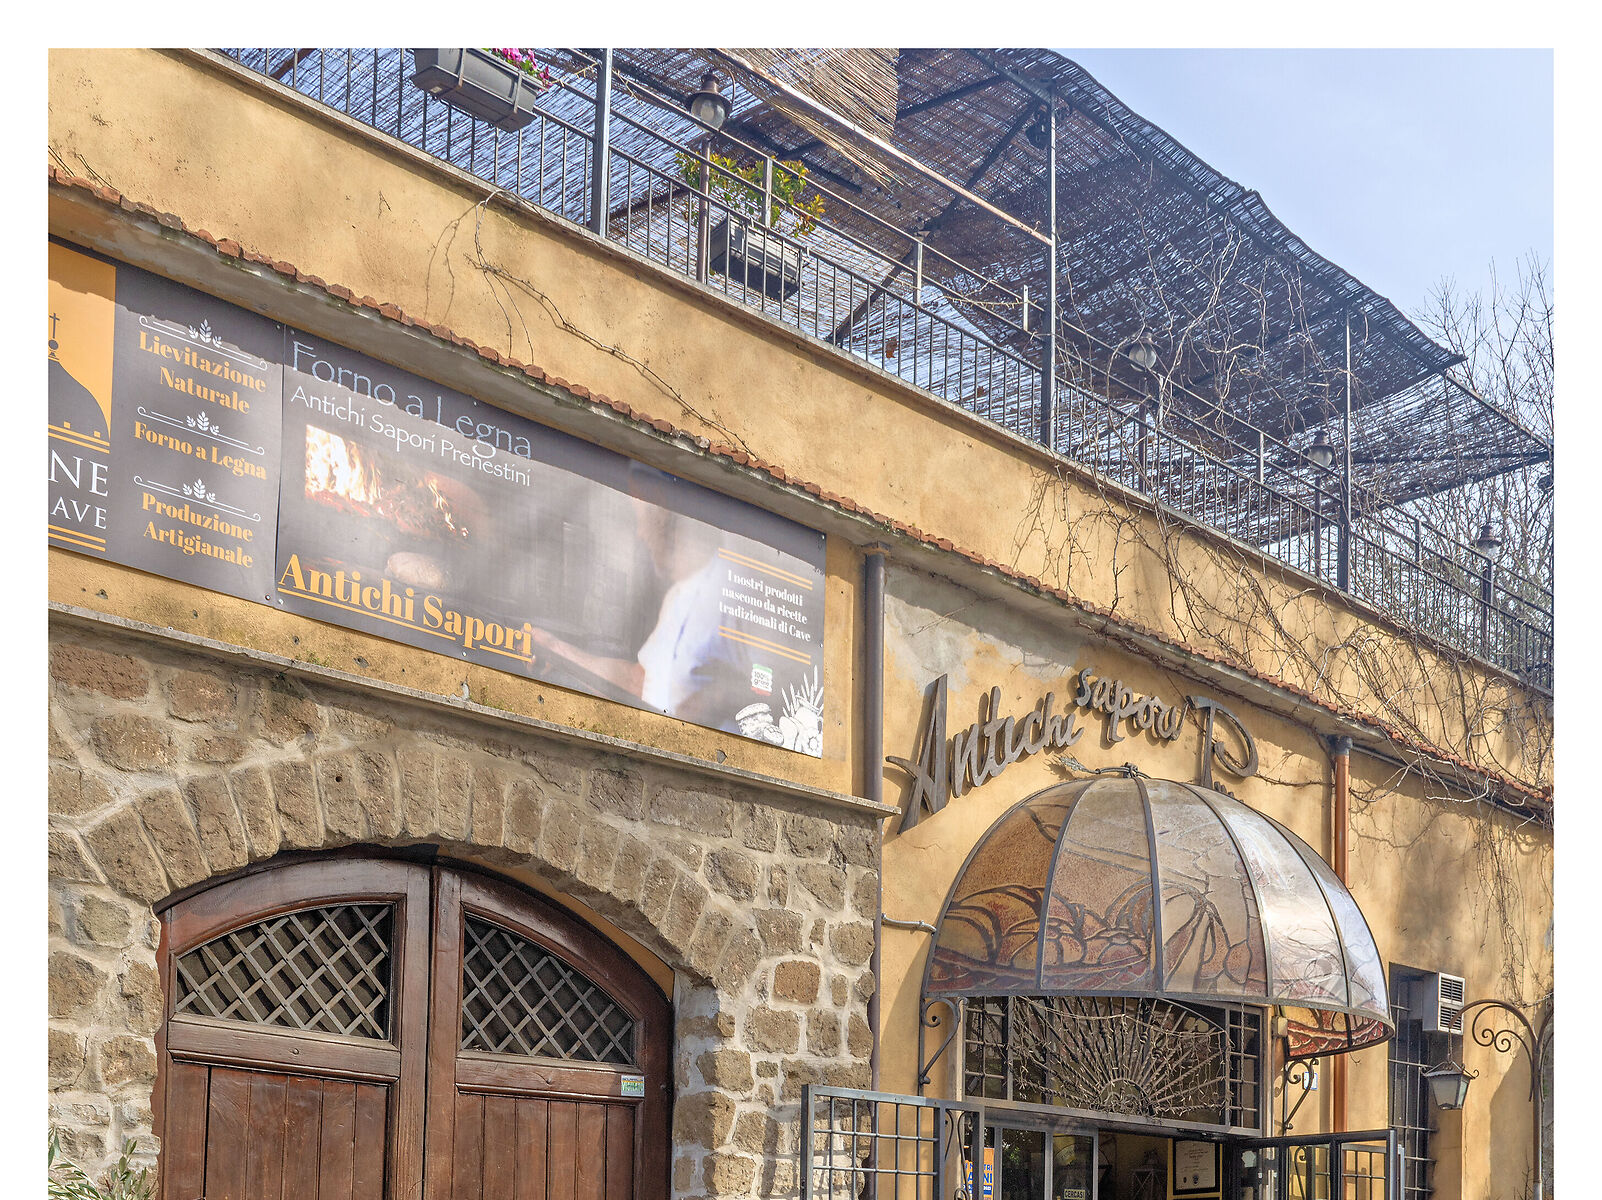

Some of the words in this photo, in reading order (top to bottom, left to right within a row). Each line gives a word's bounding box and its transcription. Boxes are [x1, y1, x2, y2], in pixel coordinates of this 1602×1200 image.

[139, 331, 266, 393] Lievitazione
[160, 366, 249, 414] Naturale
[291, 341, 396, 406] Forno
[407, 394, 424, 419] a
[436, 396, 532, 460] Legna
[134, 421, 193, 455] Forno
[195, 446, 206, 461] a
[211, 446, 267, 480] Legna
[290, 385, 365, 426] Antichi
[369, 414, 435, 452] Sapori
[441, 439, 531, 486] Prenestini
[50, 496, 107, 529] AVE
[142, 492, 253, 543] Produzione
[144, 521, 253, 568] Artigianale
[280, 554, 415, 622] Antichi
[423, 595, 533, 655] Sapori
[722, 587, 763, 608] nascono
[763, 598, 776, 613] da
[777, 605, 808, 624] ricette
[728, 569, 732, 582] I
[733, 574, 764, 592] nostri
[765, 584, 803, 606] prodotti
[719, 601, 777, 630] tradizionali
[778, 621, 788, 634] di
[788, 624, 811, 642] Cave
[886, 673, 1084, 835] Antichi
[1075, 667, 1188, 743] sapori
